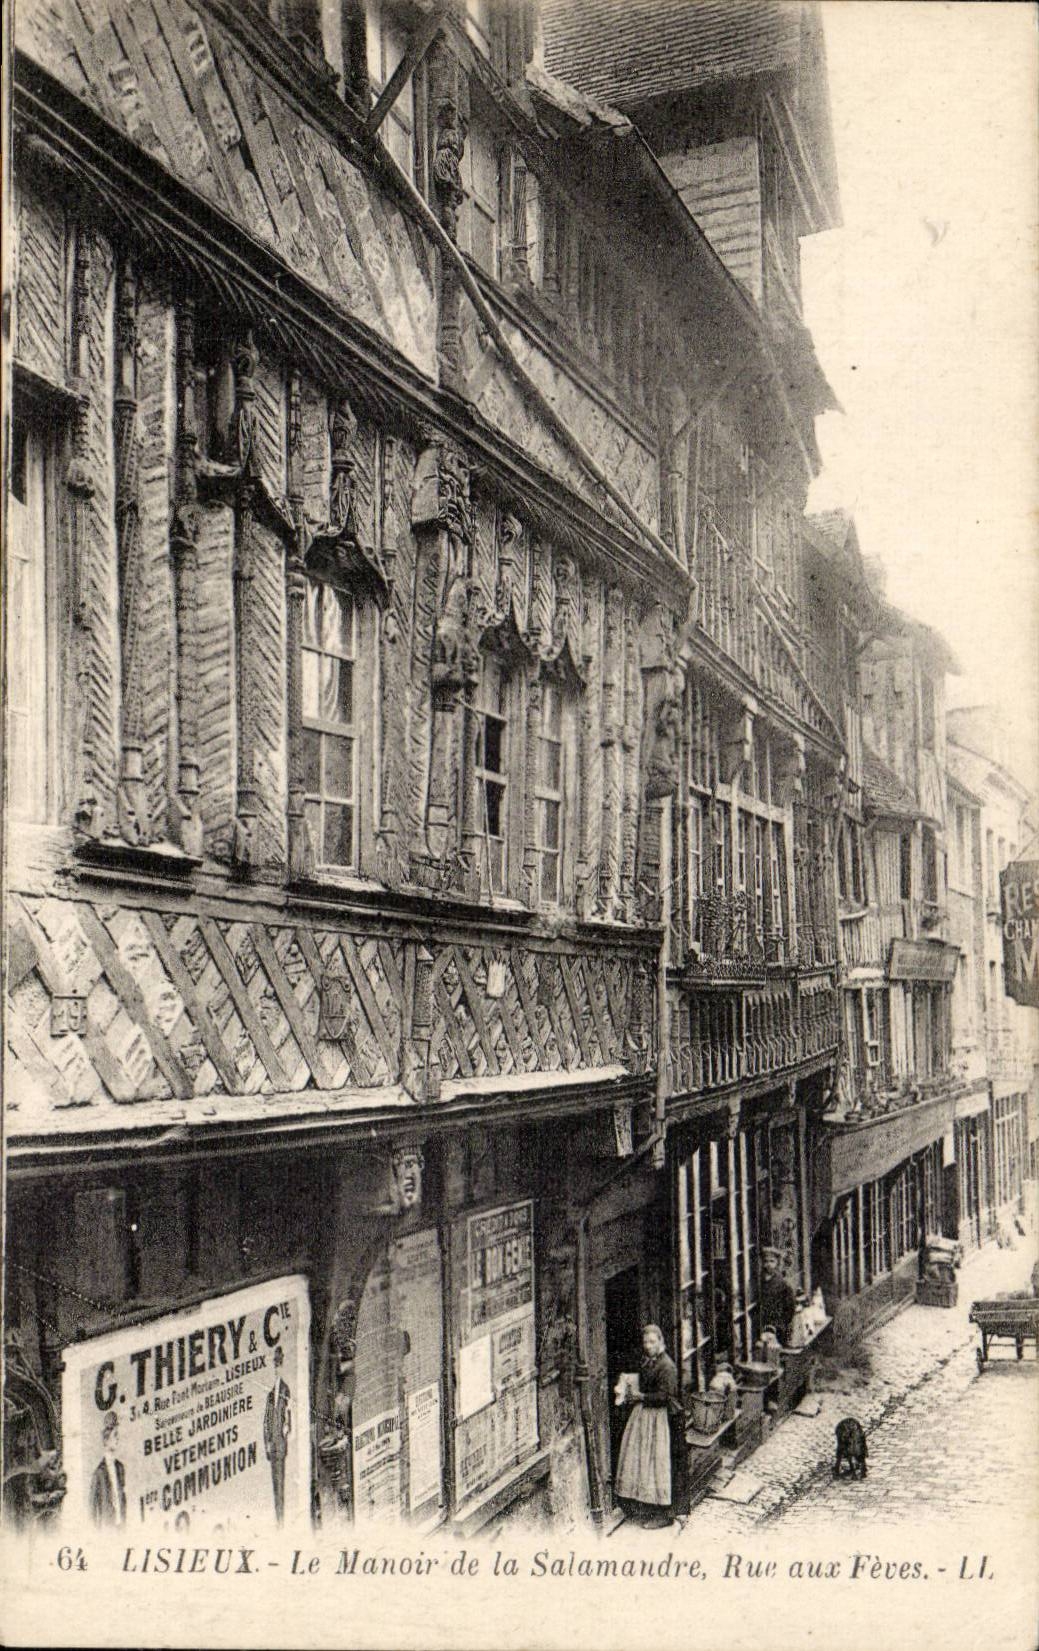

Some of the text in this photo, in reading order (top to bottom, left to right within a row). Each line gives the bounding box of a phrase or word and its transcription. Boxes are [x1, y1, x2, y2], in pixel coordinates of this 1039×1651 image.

[94, 1361, 126, 1411] G.
[204, 1381, 244, 1411] BEAUSIRE
[154, 1396, 170, 1412] Rue
[143, 1426, 183, 1456] BELLE
[162, 1441, 257, 1512] COMMUNION
